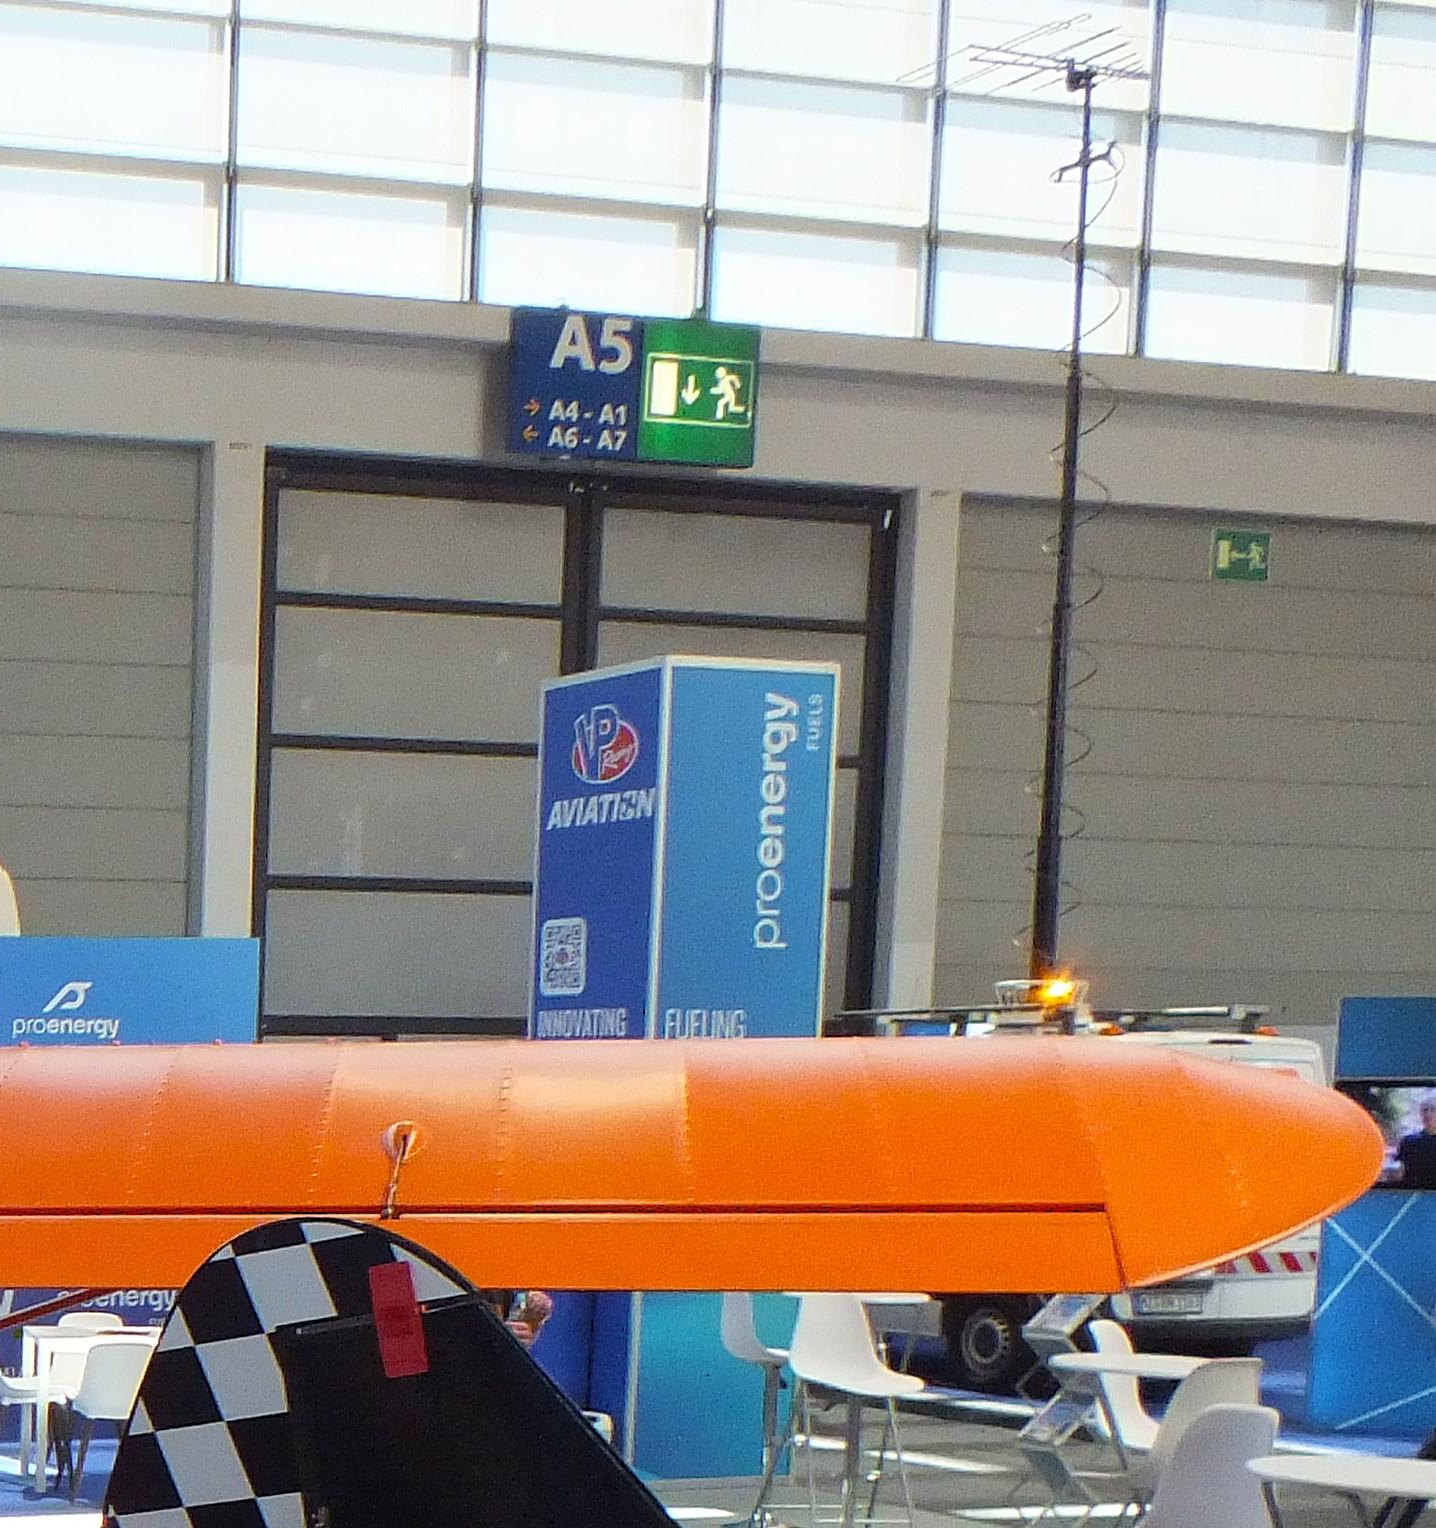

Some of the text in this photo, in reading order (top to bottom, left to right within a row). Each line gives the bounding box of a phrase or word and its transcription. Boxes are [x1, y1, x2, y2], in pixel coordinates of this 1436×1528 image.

[549, 314, 633, 375] A5
[548, 399, 579, 422] A4
[598, 403, 627, 426] A1
[547, 425, 579, 449] A6
[596, 429, 627, 451] A7
[574, 704, 620, 783] VP
[546, 787, 656, 831] AVIATION
[753, 692, 801, 950] proenergy
[11, 1017, 119, 1040] proenergy
[537, 1008, 627, 1039] INNOVATING
[665, 1008, 748, 1040] FUELING
